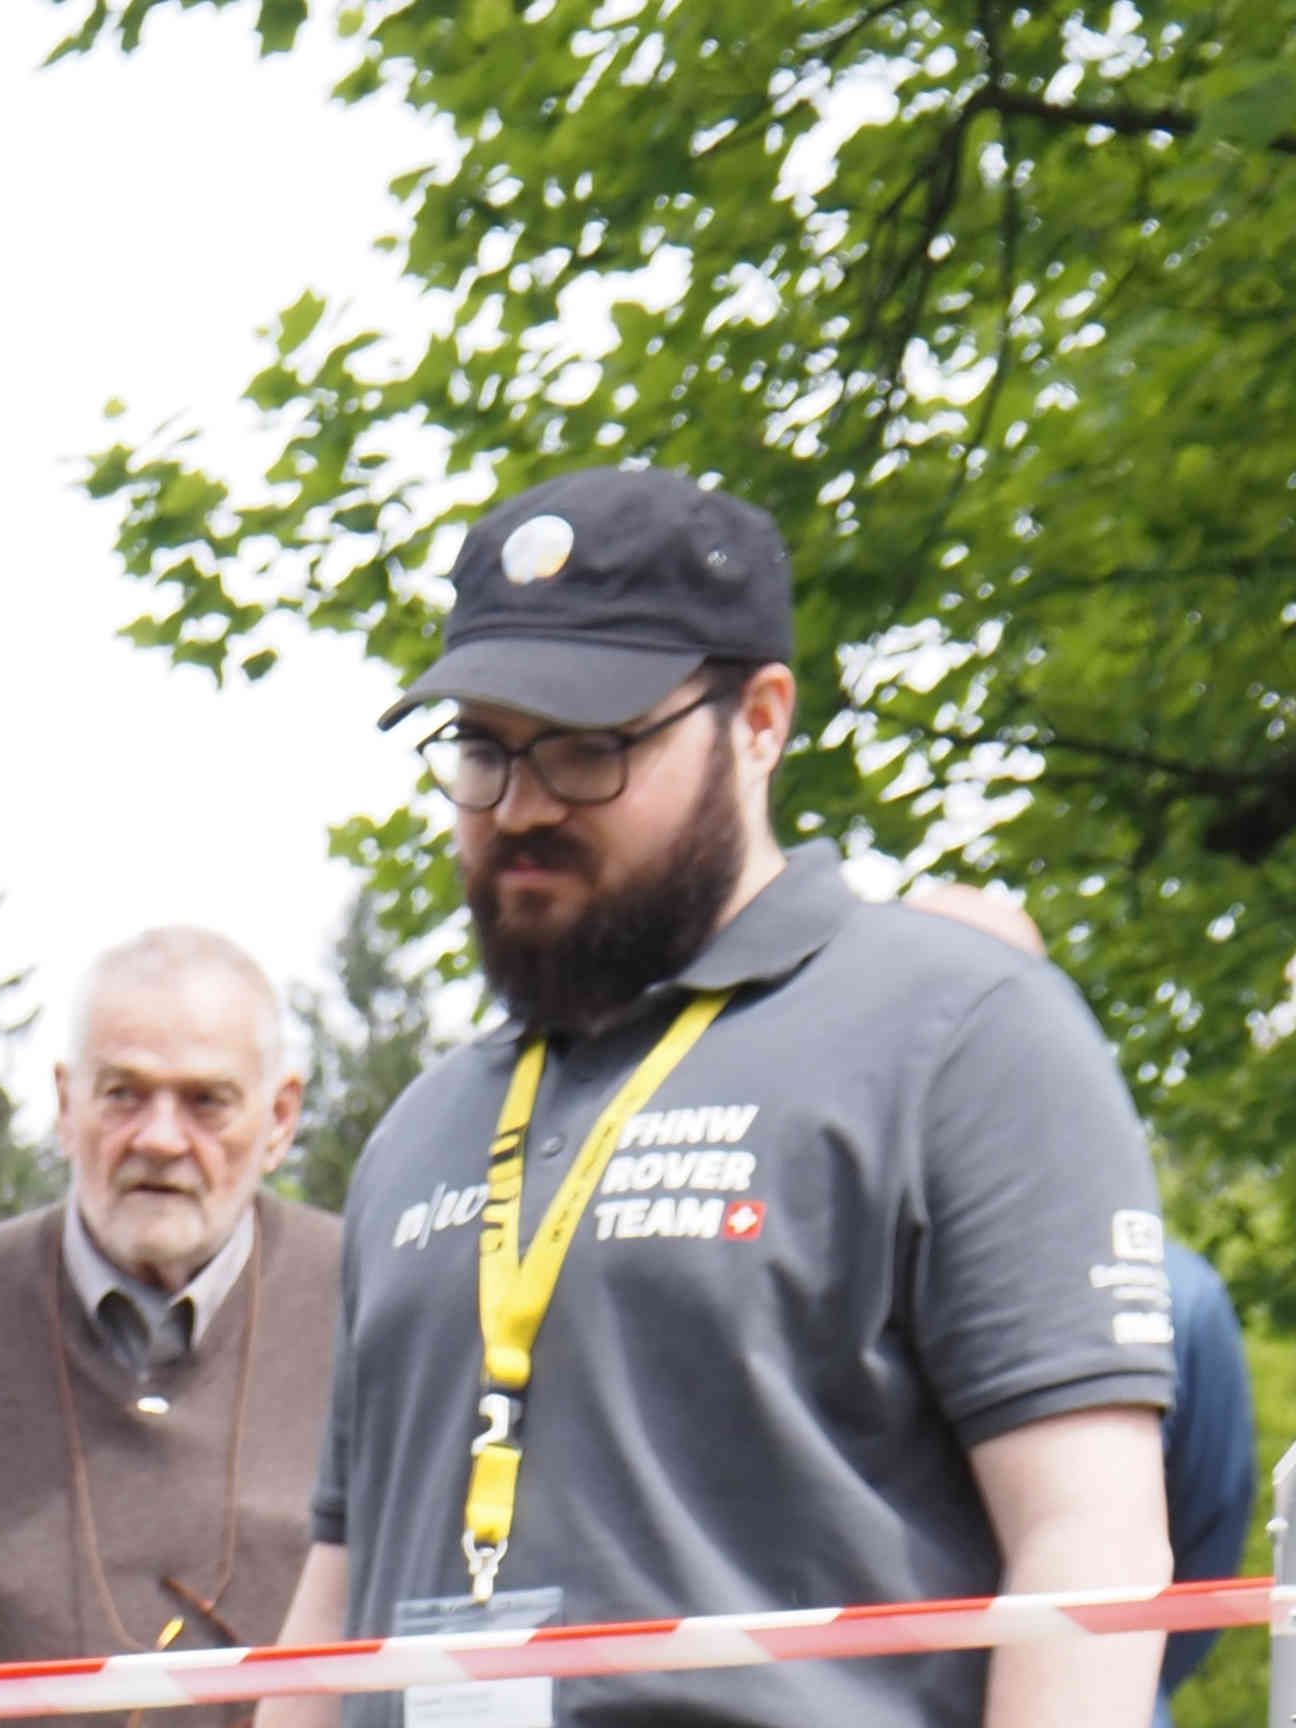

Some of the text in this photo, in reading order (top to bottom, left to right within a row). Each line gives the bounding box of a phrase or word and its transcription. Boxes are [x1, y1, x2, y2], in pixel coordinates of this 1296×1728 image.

[619, 1104, 760, 1149] FHNW
[601, 1150, 757, 1194] ROVER
[594, 1197, 725, 1240] TEAM
